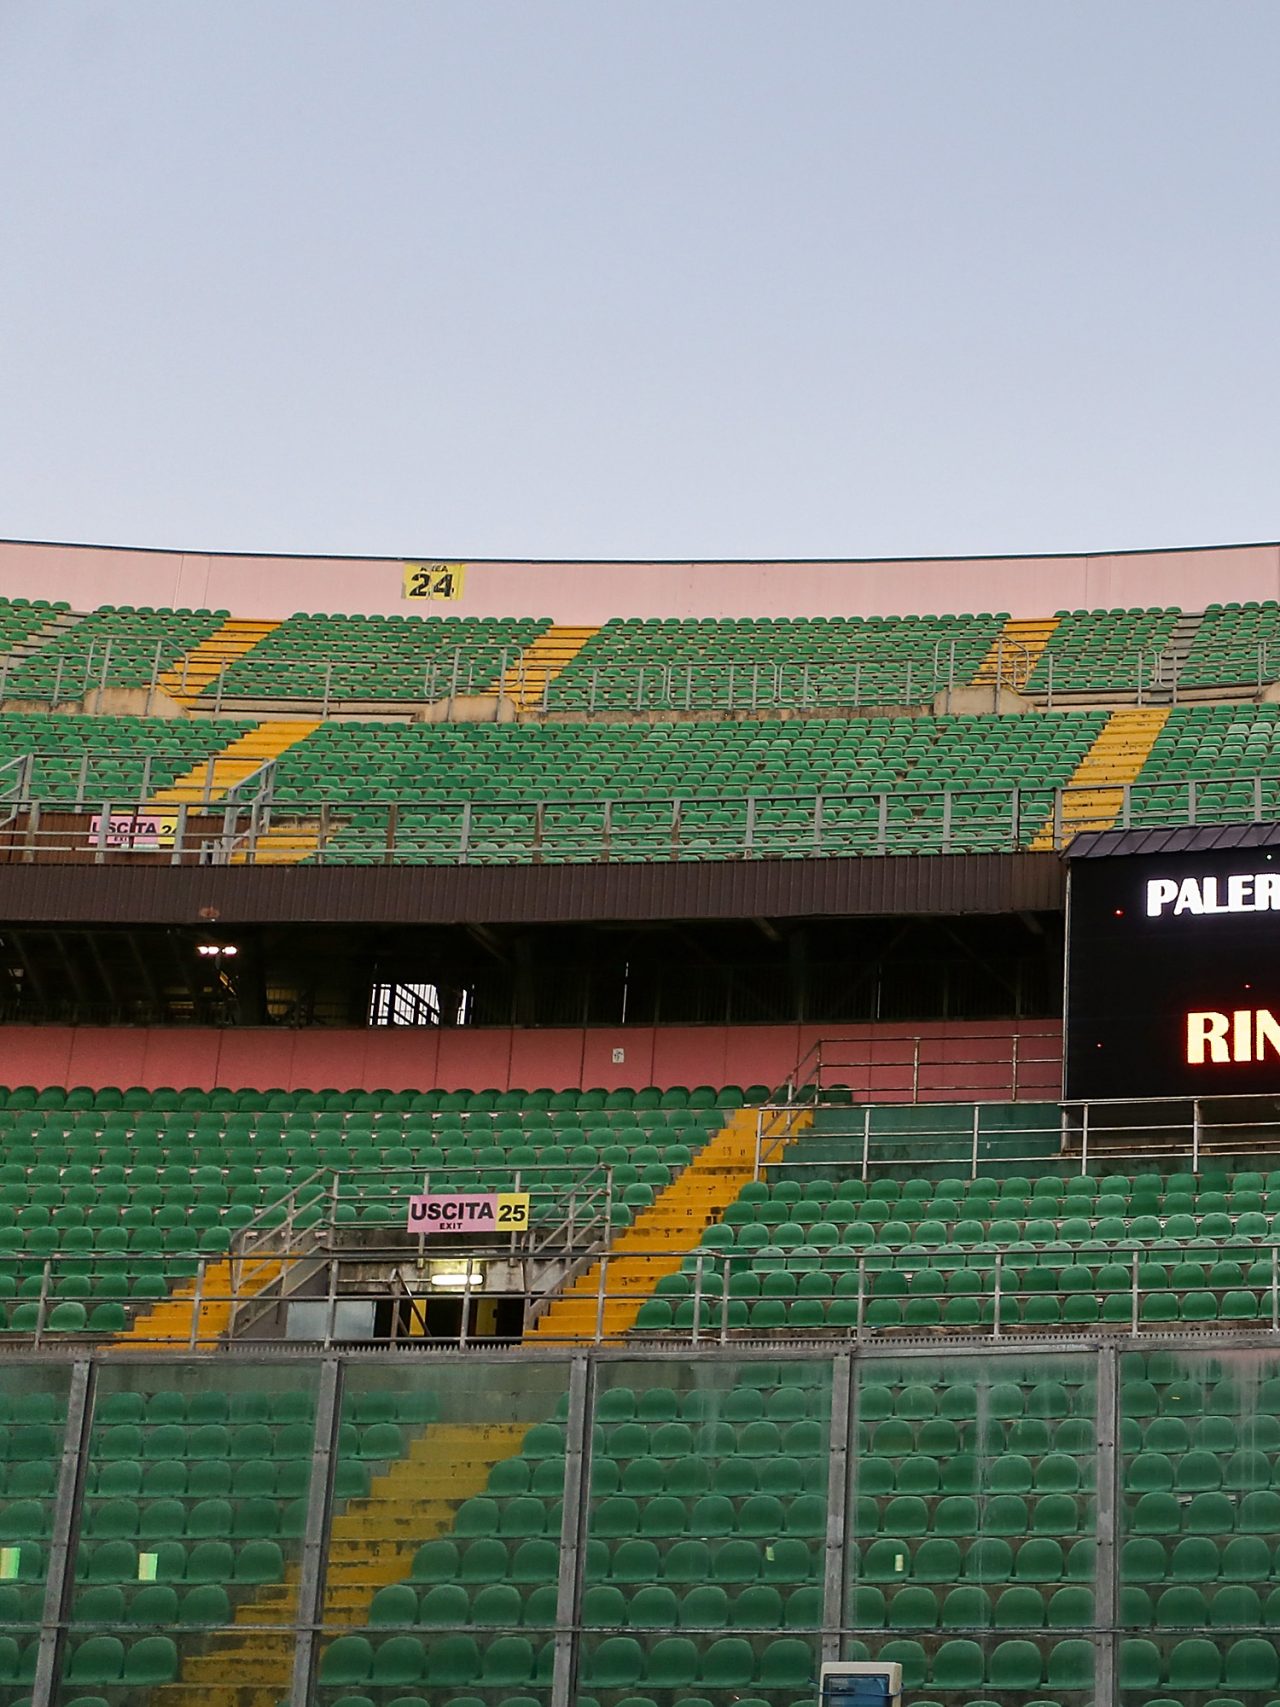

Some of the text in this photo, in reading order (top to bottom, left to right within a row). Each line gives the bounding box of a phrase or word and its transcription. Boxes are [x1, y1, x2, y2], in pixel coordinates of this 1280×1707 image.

[409, 573, 453, 597] 24
[411, 1202, 526, 1222] USCITA 25
[440, 1222, 463, 1230] EXIT
